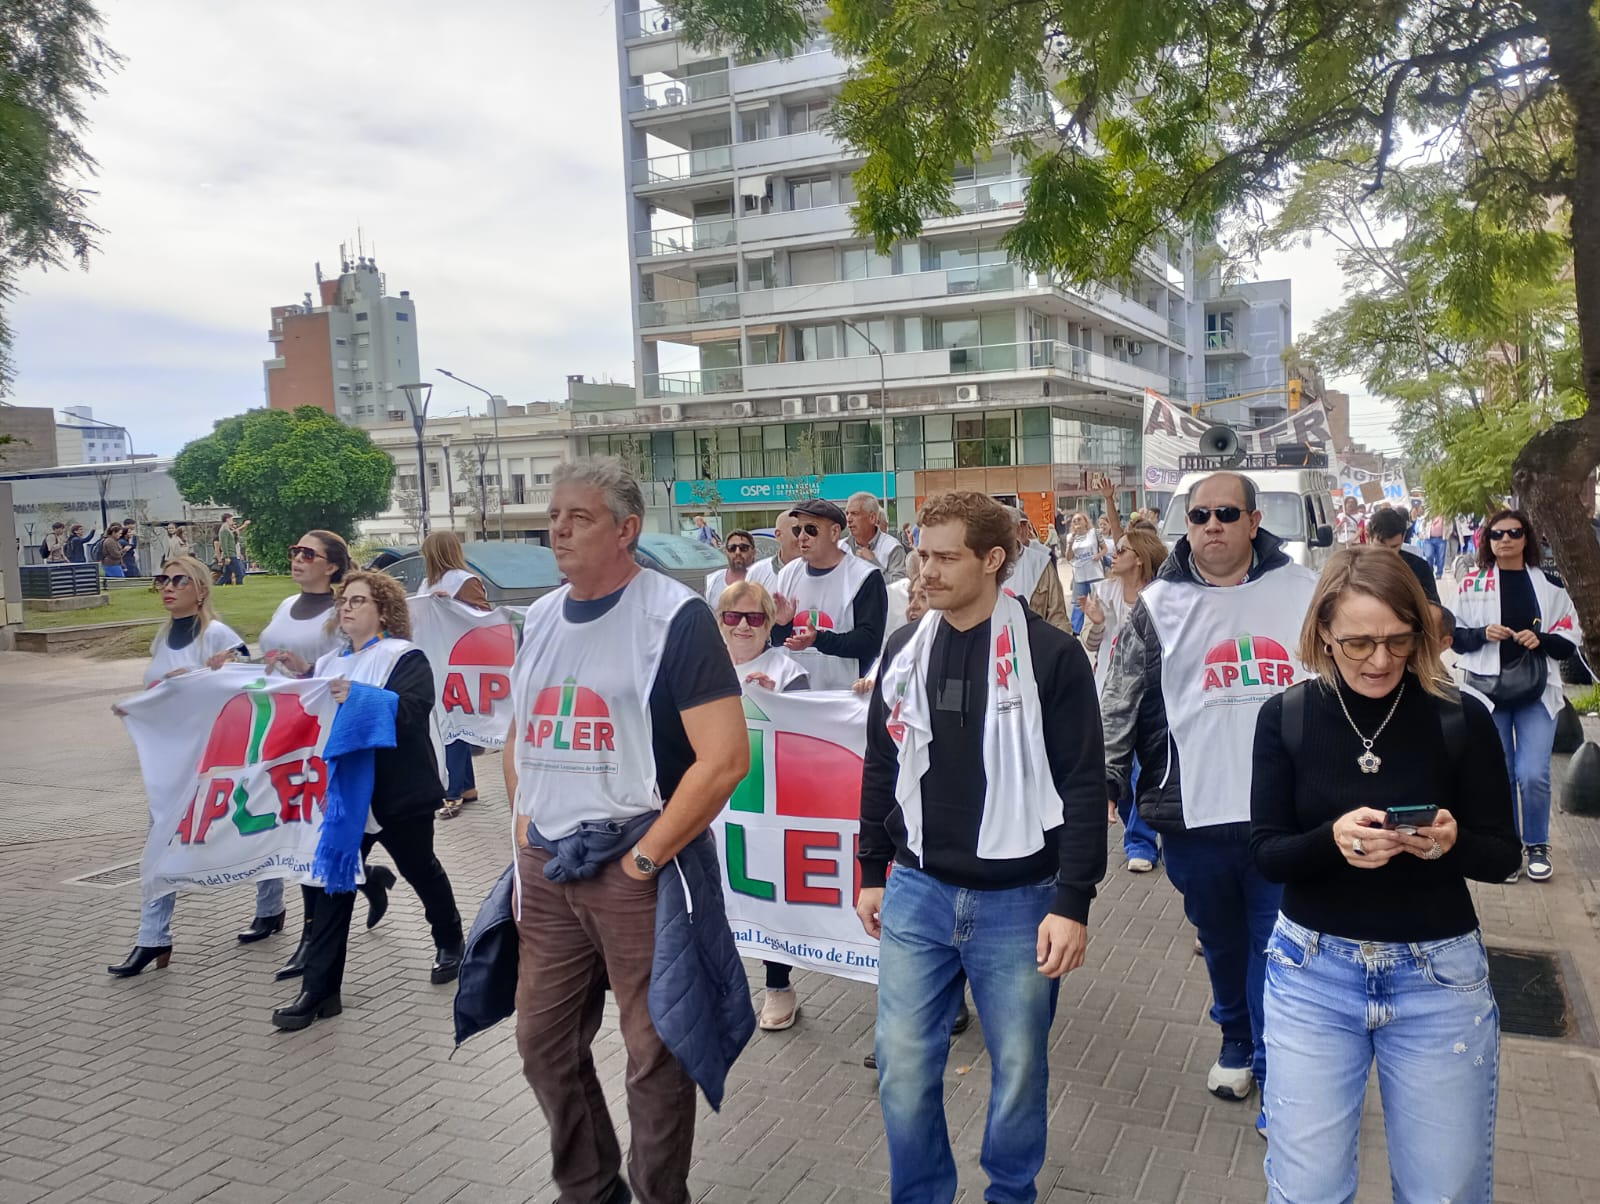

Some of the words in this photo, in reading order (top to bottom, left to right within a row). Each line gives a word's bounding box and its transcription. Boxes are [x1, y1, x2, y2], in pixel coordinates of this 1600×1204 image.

[1203, 662, 1294, 691] APLER
[756, 930, 823, 960] Legislativo
[826, 947, 843, 963] de
